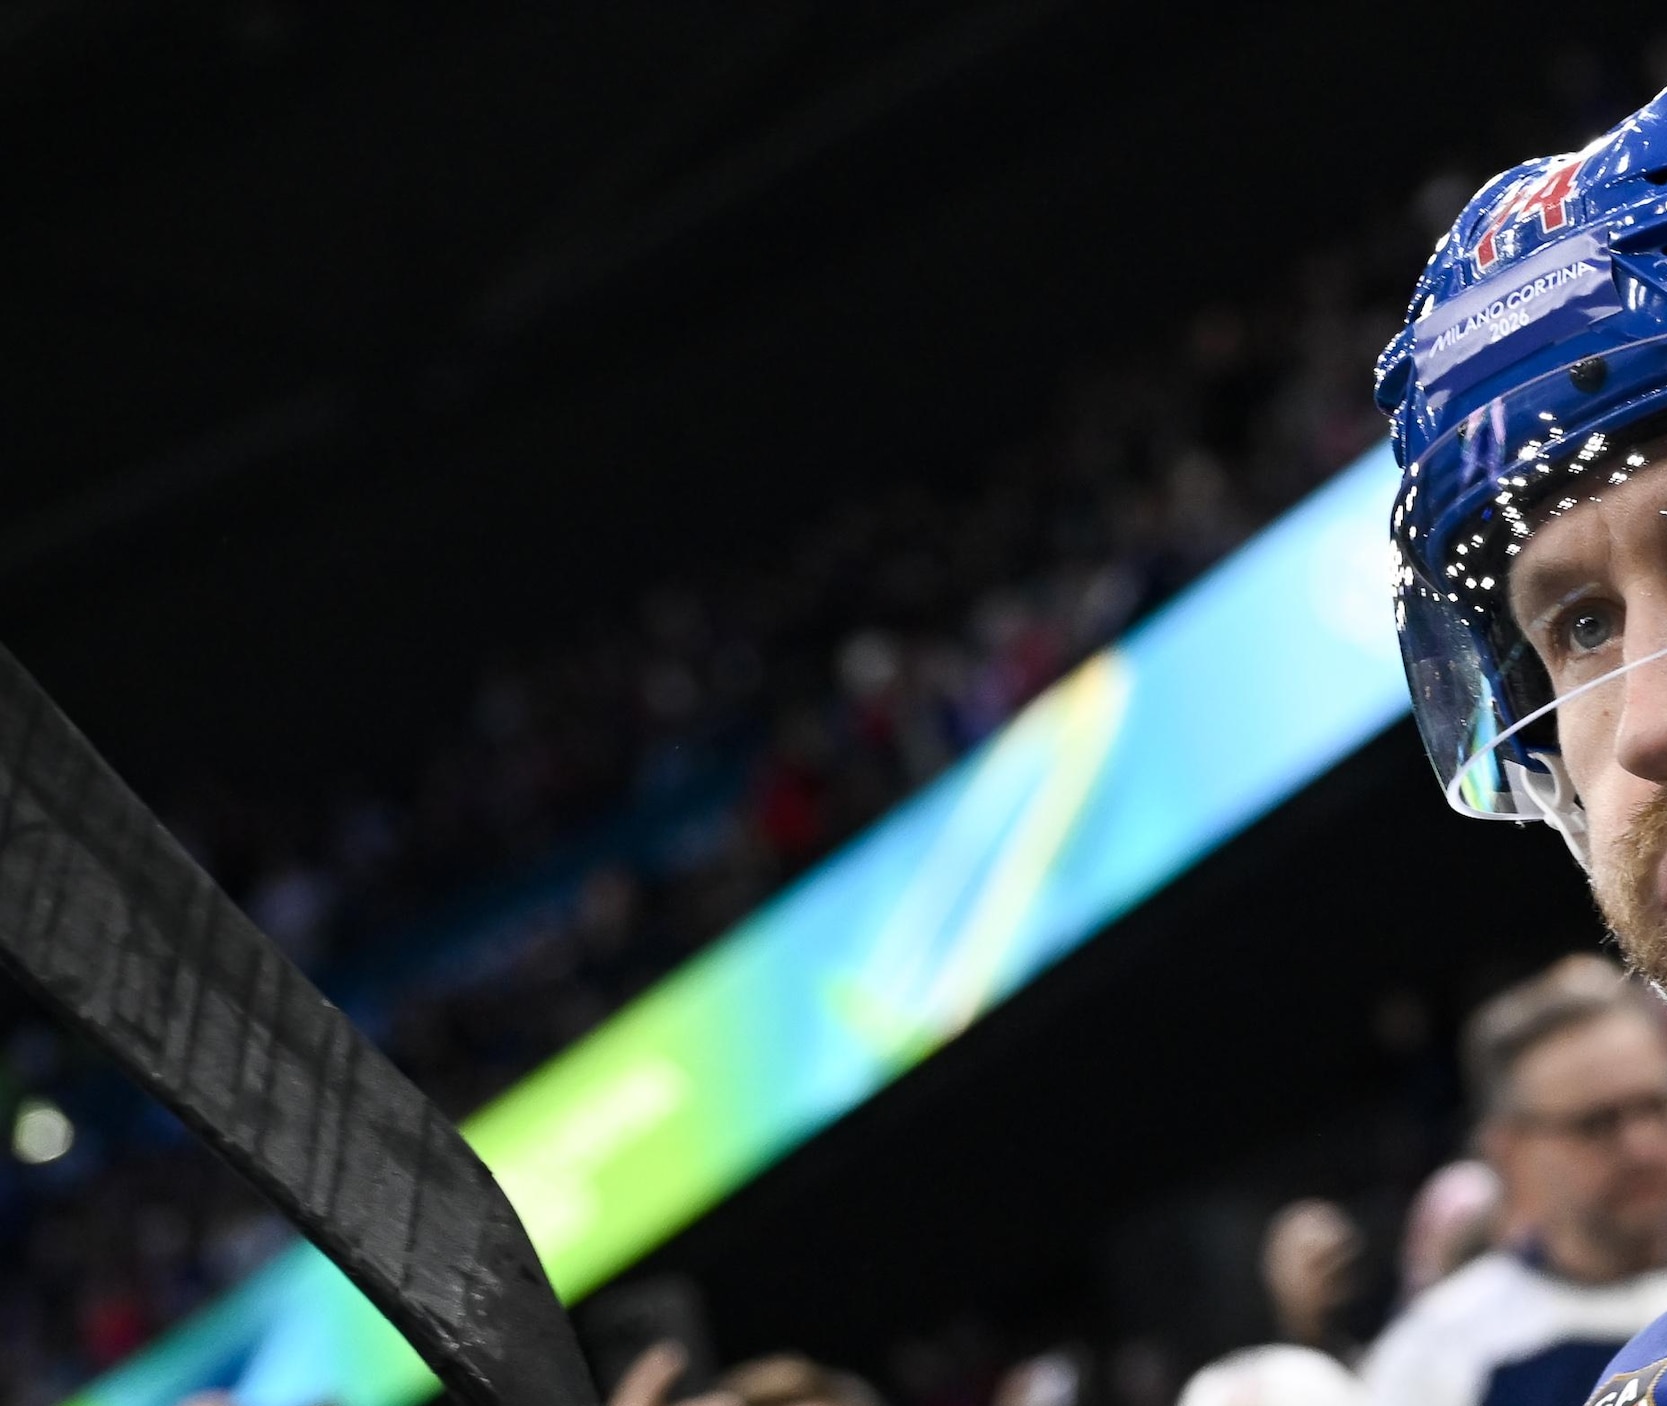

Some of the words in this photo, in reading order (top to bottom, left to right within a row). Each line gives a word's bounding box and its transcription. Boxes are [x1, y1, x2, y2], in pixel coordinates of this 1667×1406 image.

[1428, 302, 1504, 358] MILANO
[1507, 261, 1597, 310] CORTINA
[1489, 309, 1530, 342] 2026
